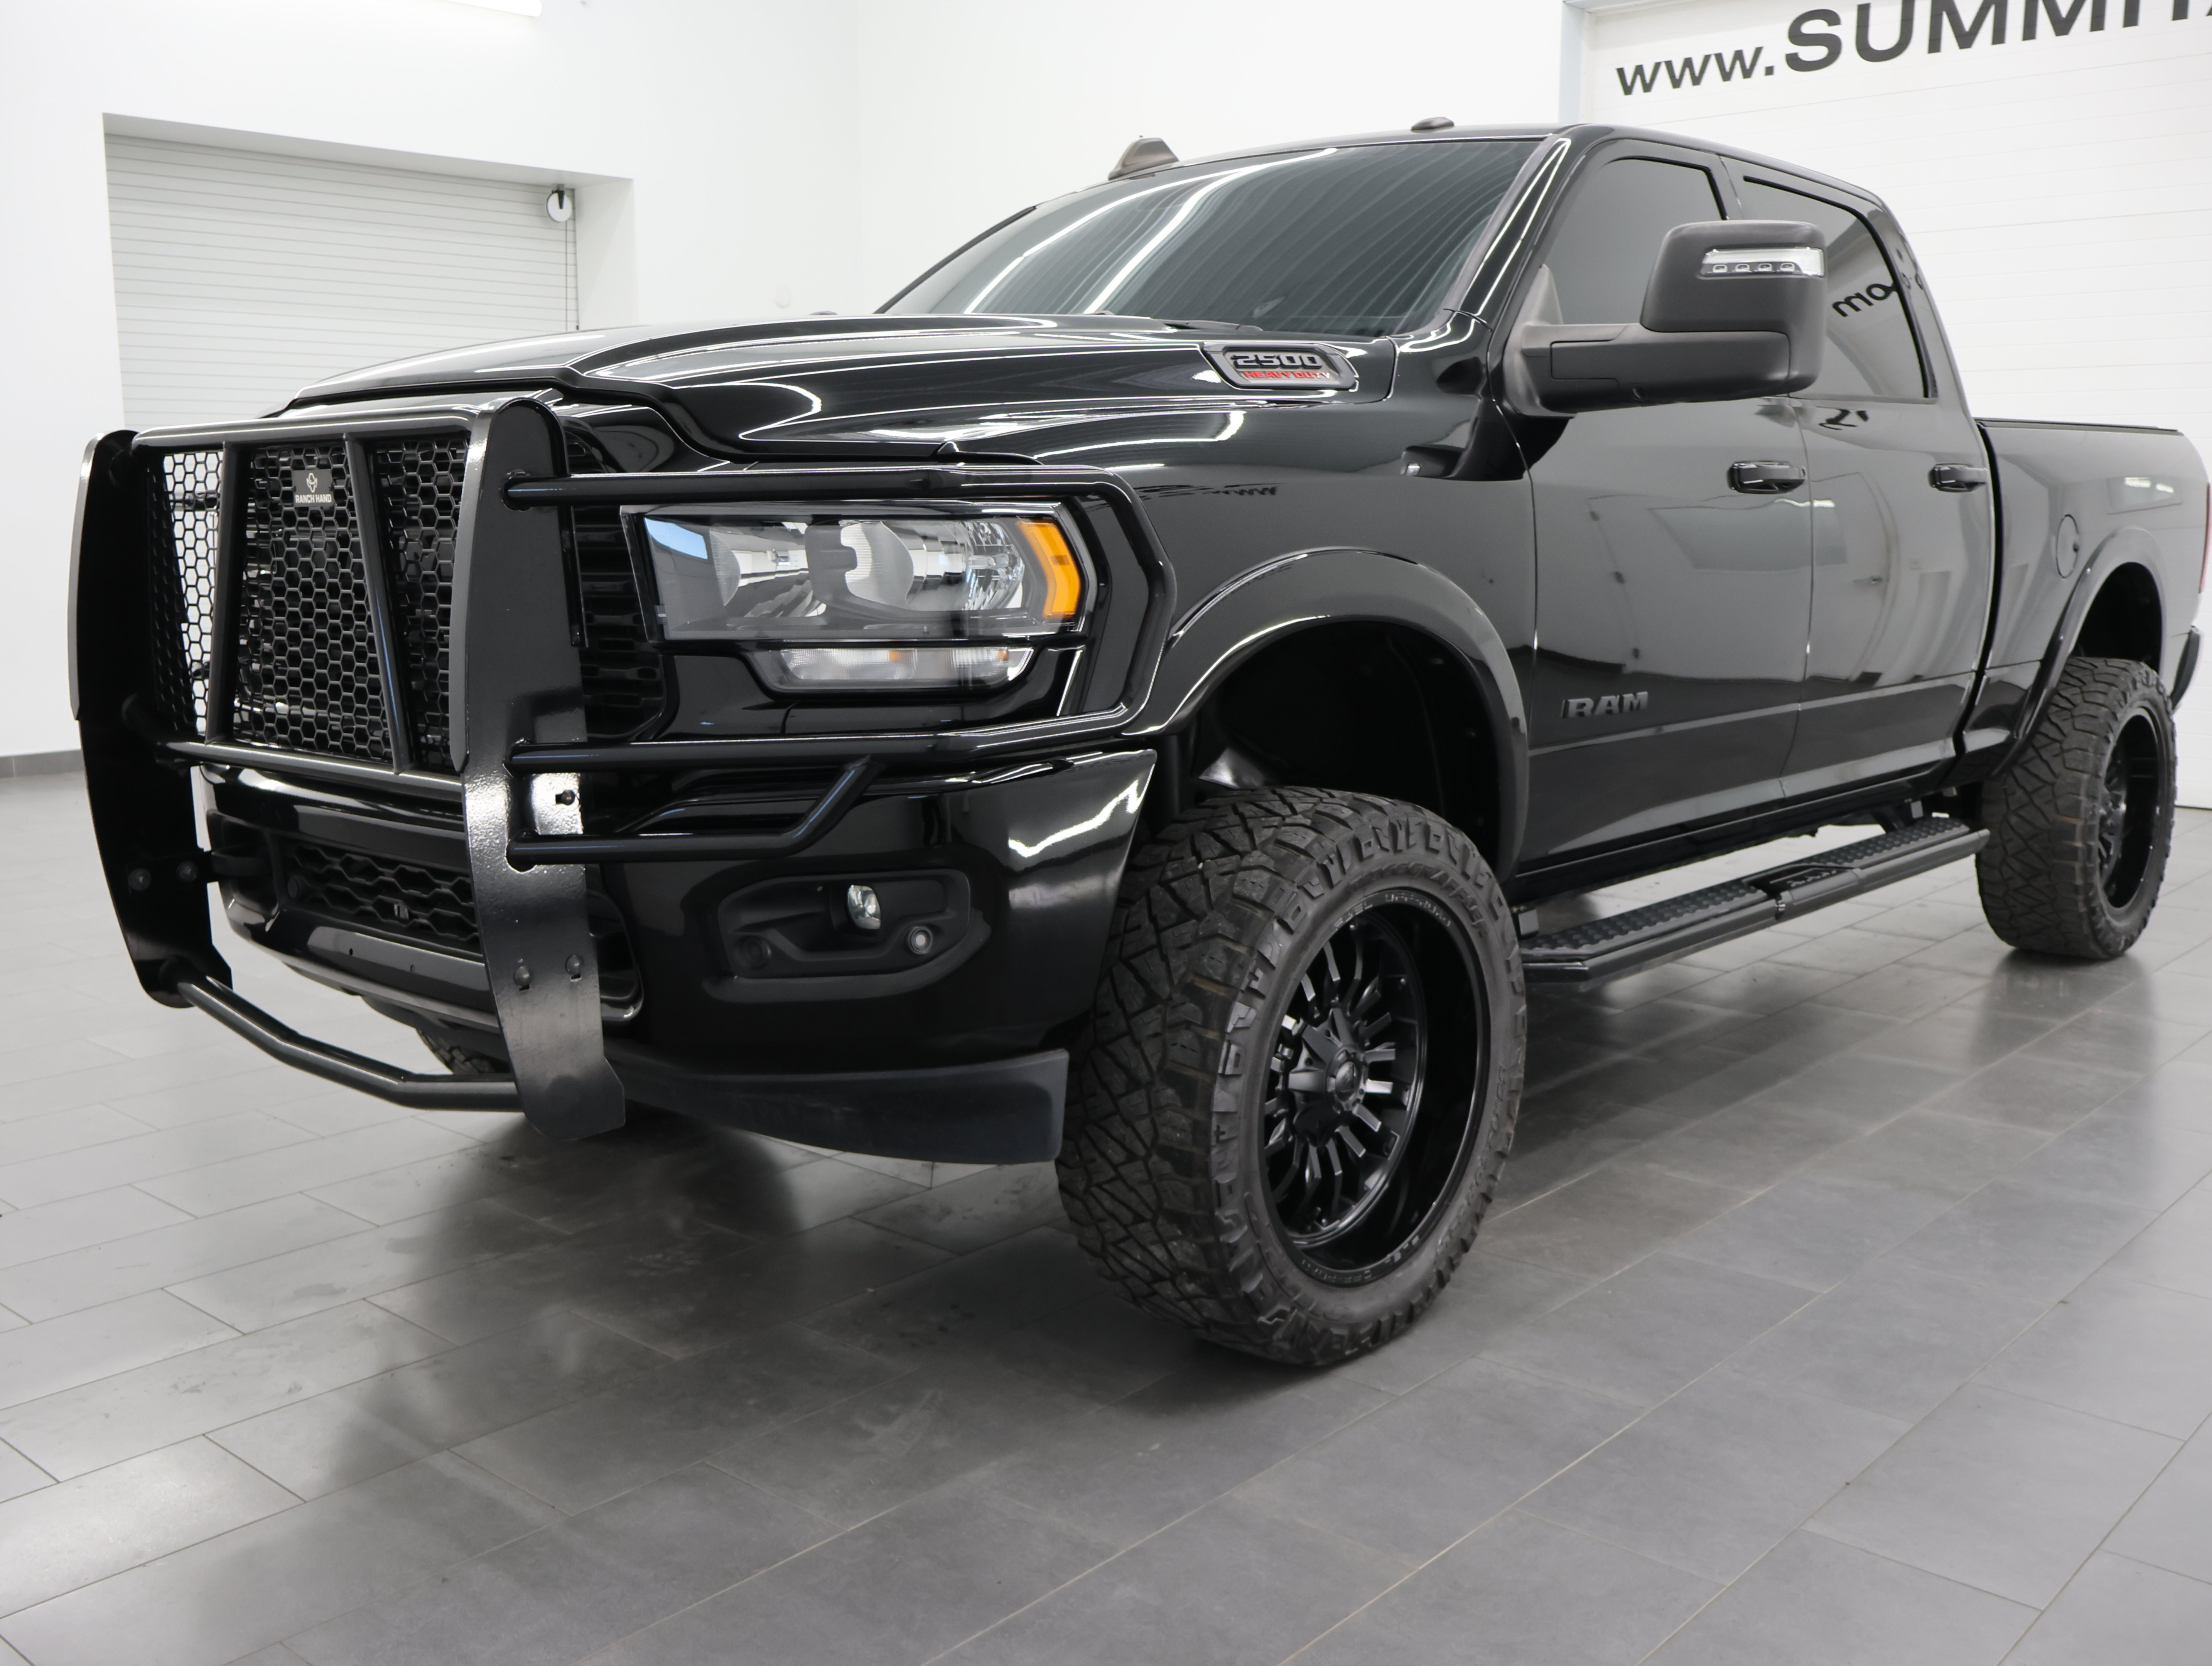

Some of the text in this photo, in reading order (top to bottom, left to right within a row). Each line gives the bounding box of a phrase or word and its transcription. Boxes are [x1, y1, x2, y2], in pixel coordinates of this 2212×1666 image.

[1616, 0, 2212, 95] www.SUMM
[1231, 354, 1322, 369] 2500
[295, 494, 332, 503] RANCH HAND
[1562, 691, 1648, 718] RAM
